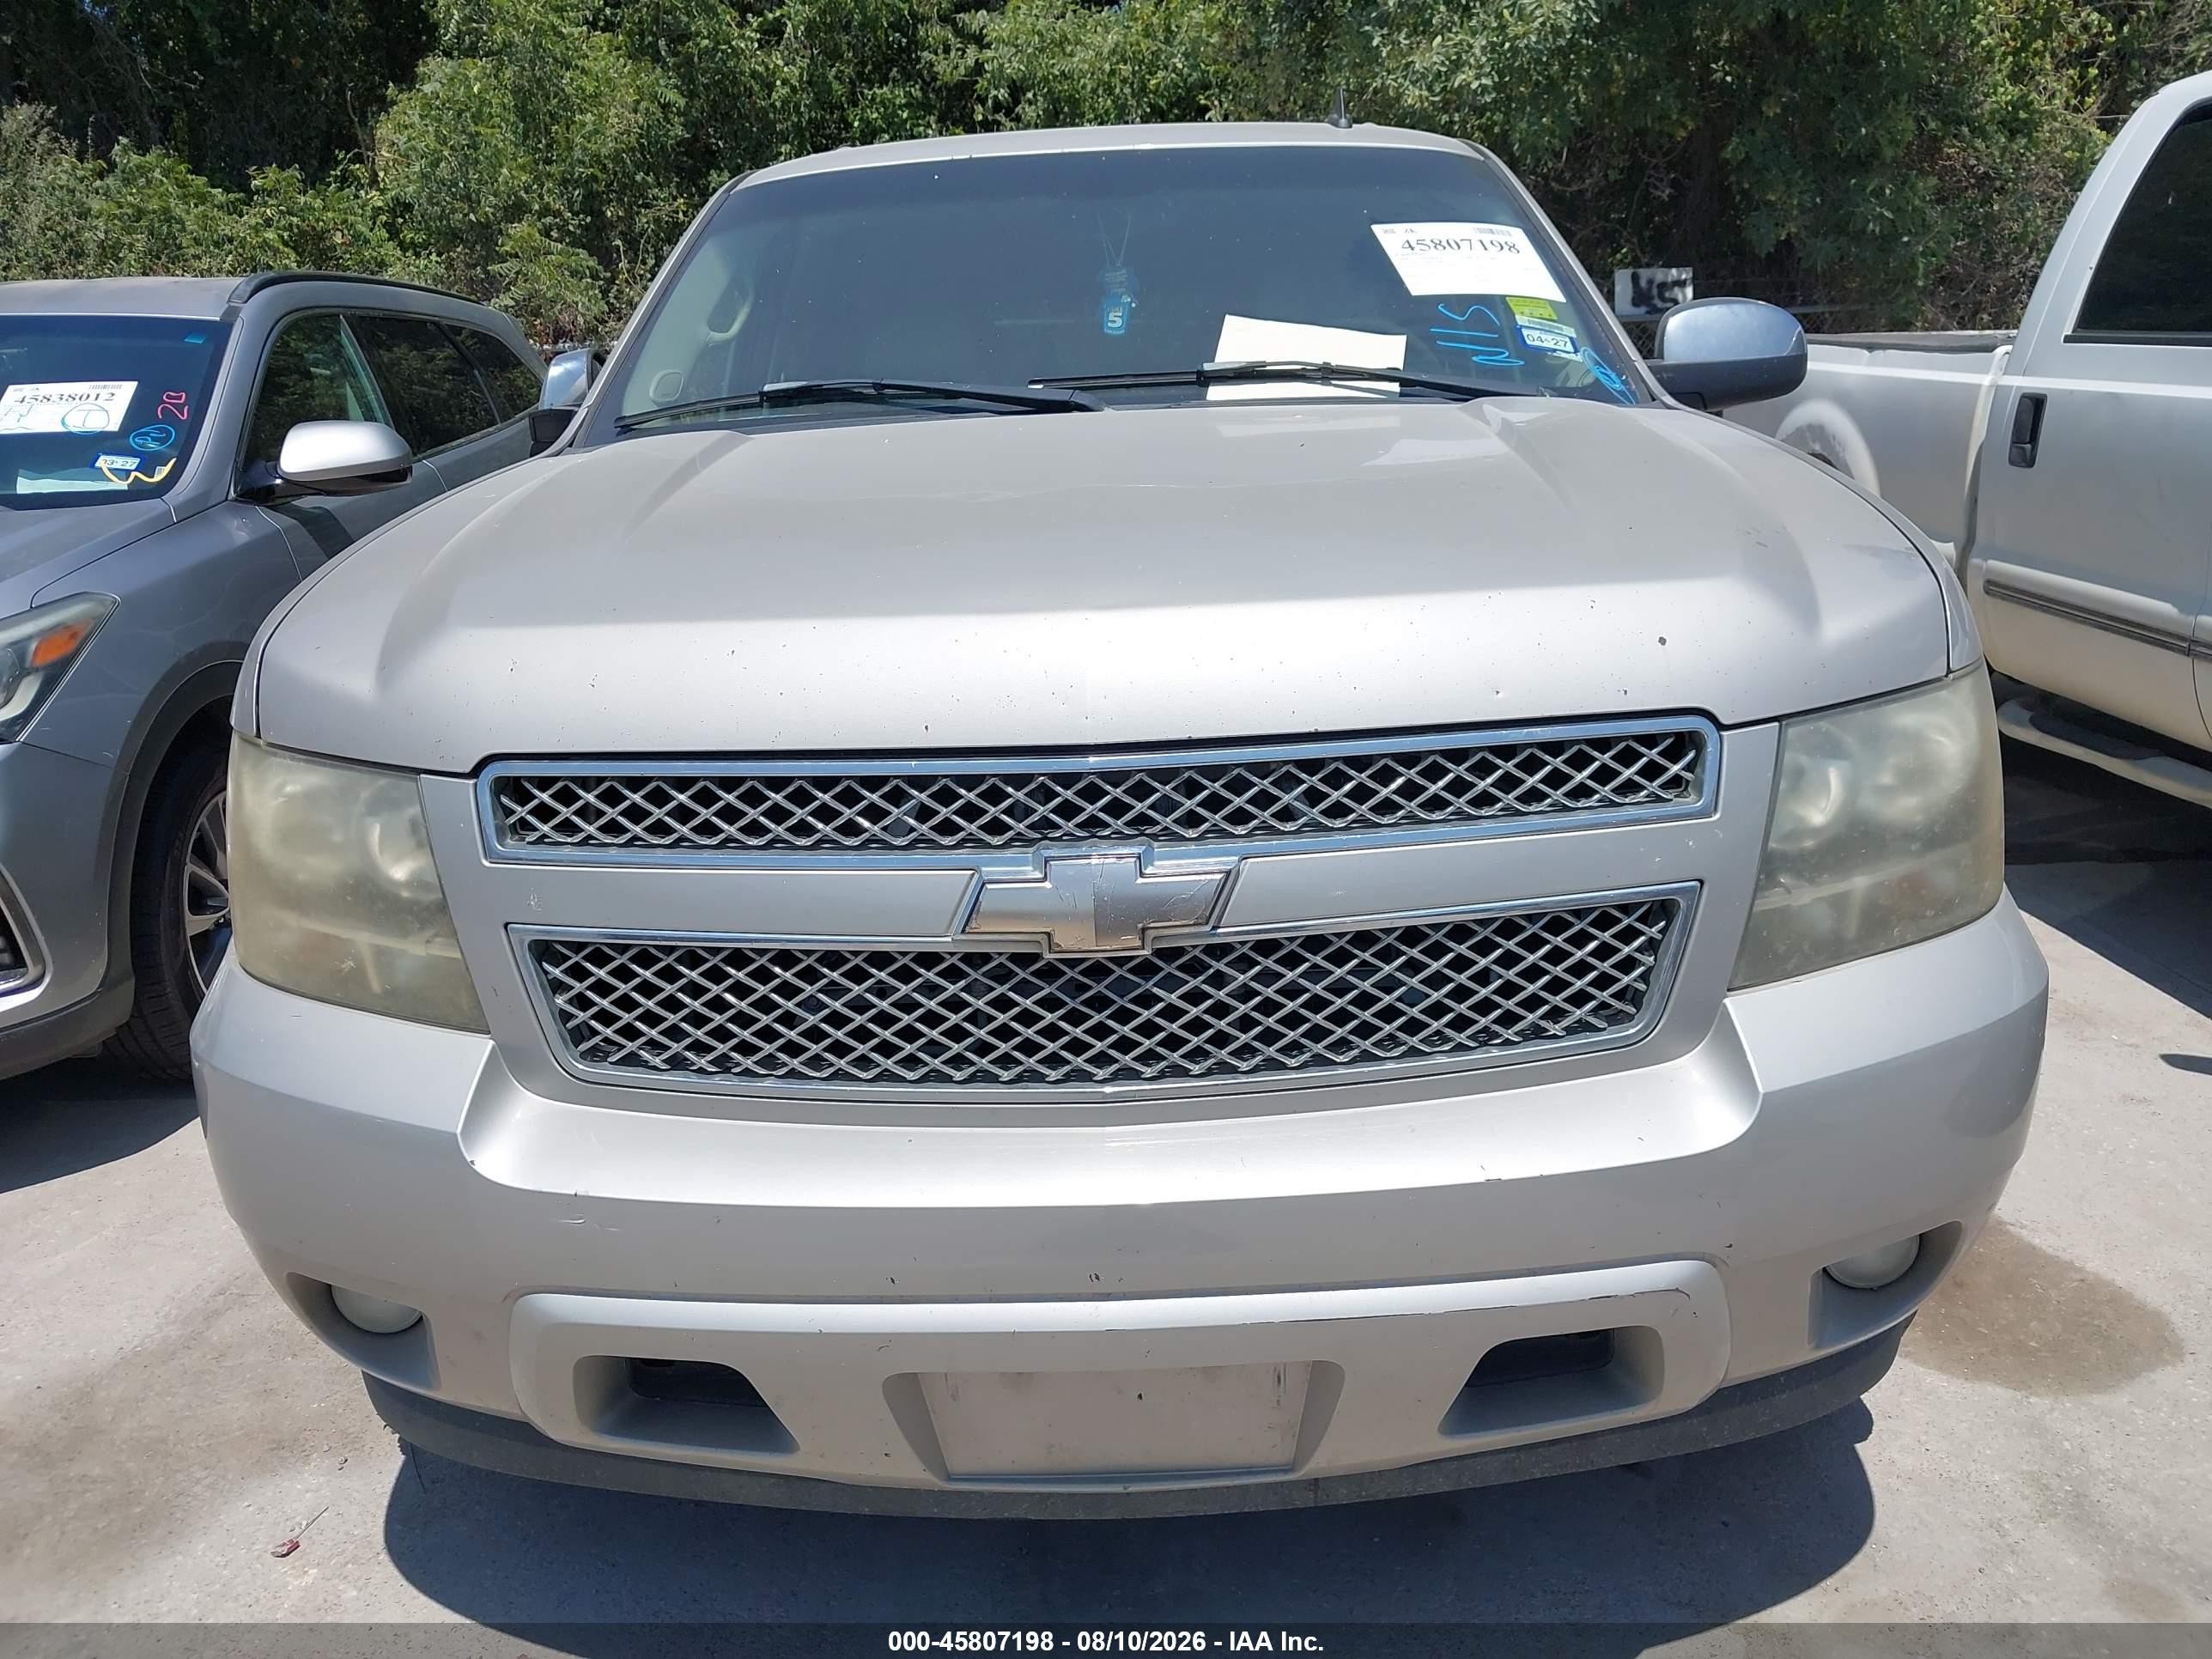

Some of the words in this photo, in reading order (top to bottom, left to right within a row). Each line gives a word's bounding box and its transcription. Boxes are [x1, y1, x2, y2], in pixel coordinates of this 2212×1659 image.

[1401, 237, 1522, 255] 45807198
[1526, 332, 1569, 349] 04-27
[14, 392, 116, 404] 45838012
